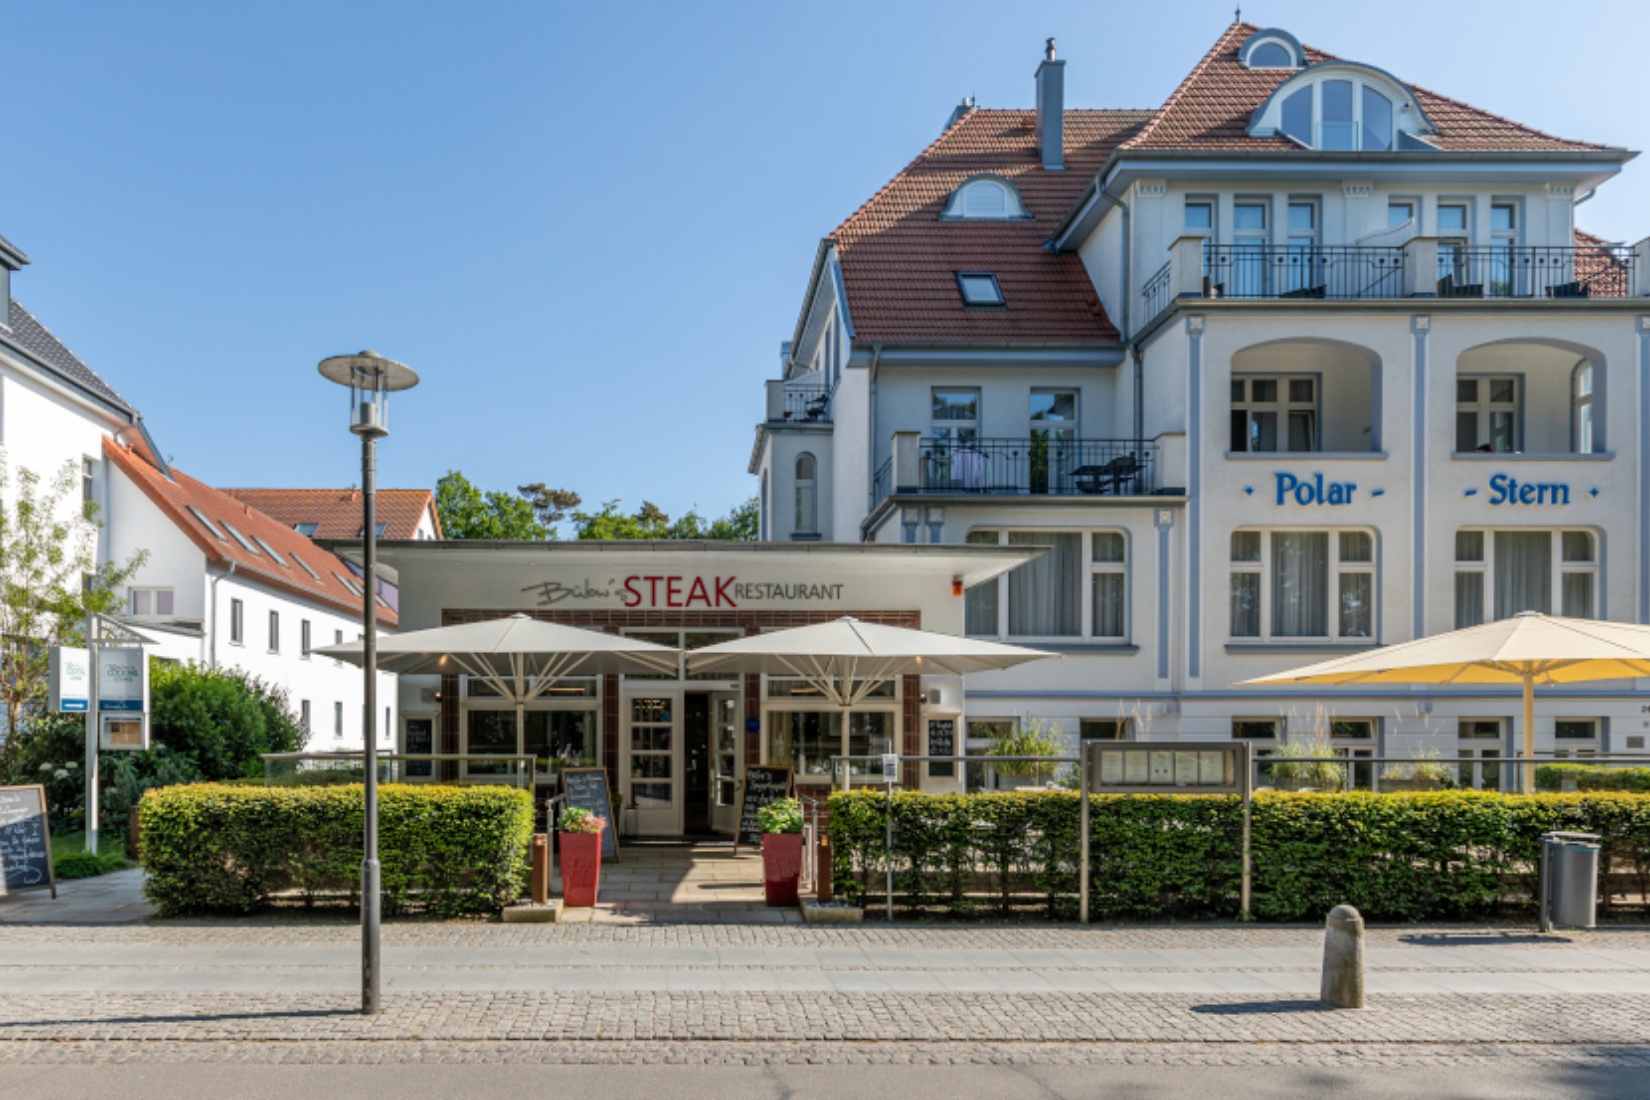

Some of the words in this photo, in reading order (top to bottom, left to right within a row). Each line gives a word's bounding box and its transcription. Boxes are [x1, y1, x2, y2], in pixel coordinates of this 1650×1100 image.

[1273, 473, 1358, 505] Polar
[1487, 474, 1570, 505] Stern
[624, 576, 738, 607] STEAK
[735, 583, 844, 600] RESTAURANT
